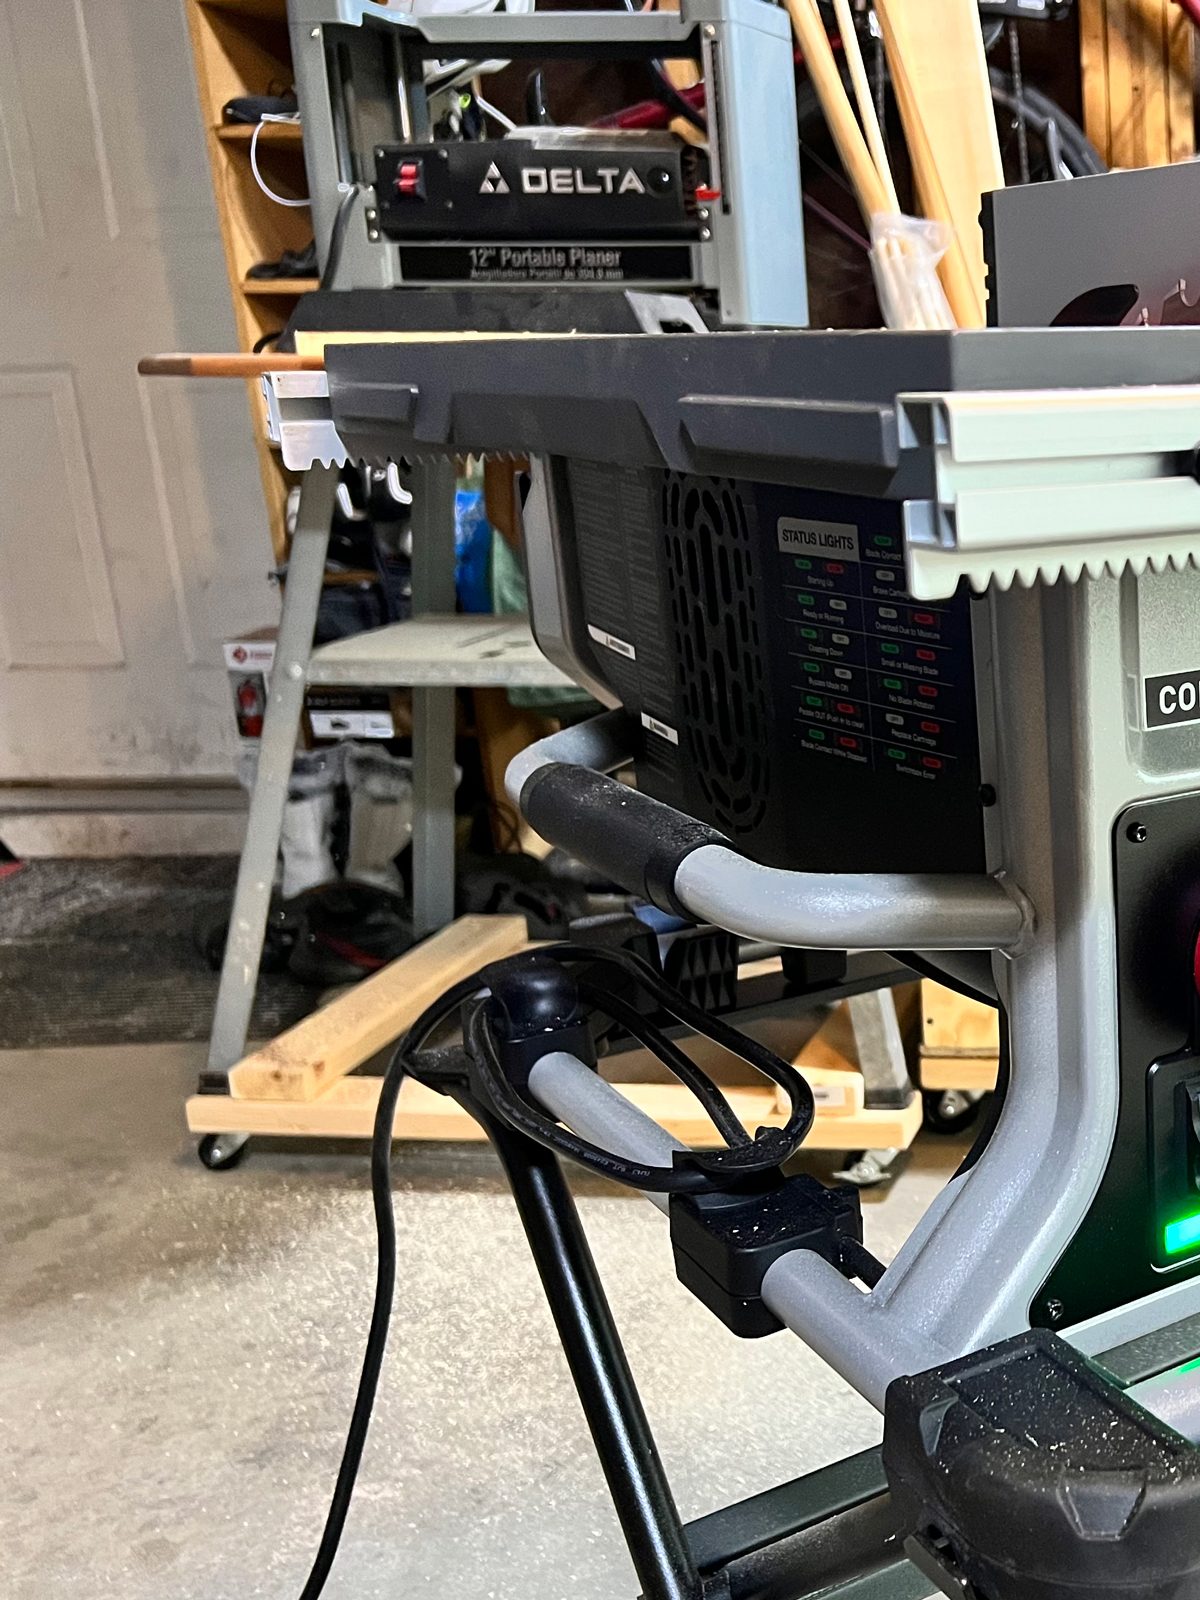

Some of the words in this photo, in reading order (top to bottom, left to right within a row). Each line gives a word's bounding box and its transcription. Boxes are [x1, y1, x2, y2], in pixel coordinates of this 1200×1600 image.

[521, 167, 646, 194] DELTA
[501, 248, 566, 267] Portable
[569, 248, 621, 267] Planer
[782, 529, 817, 545] STATUS
[819, 533, 854, 550] LIGHTS
